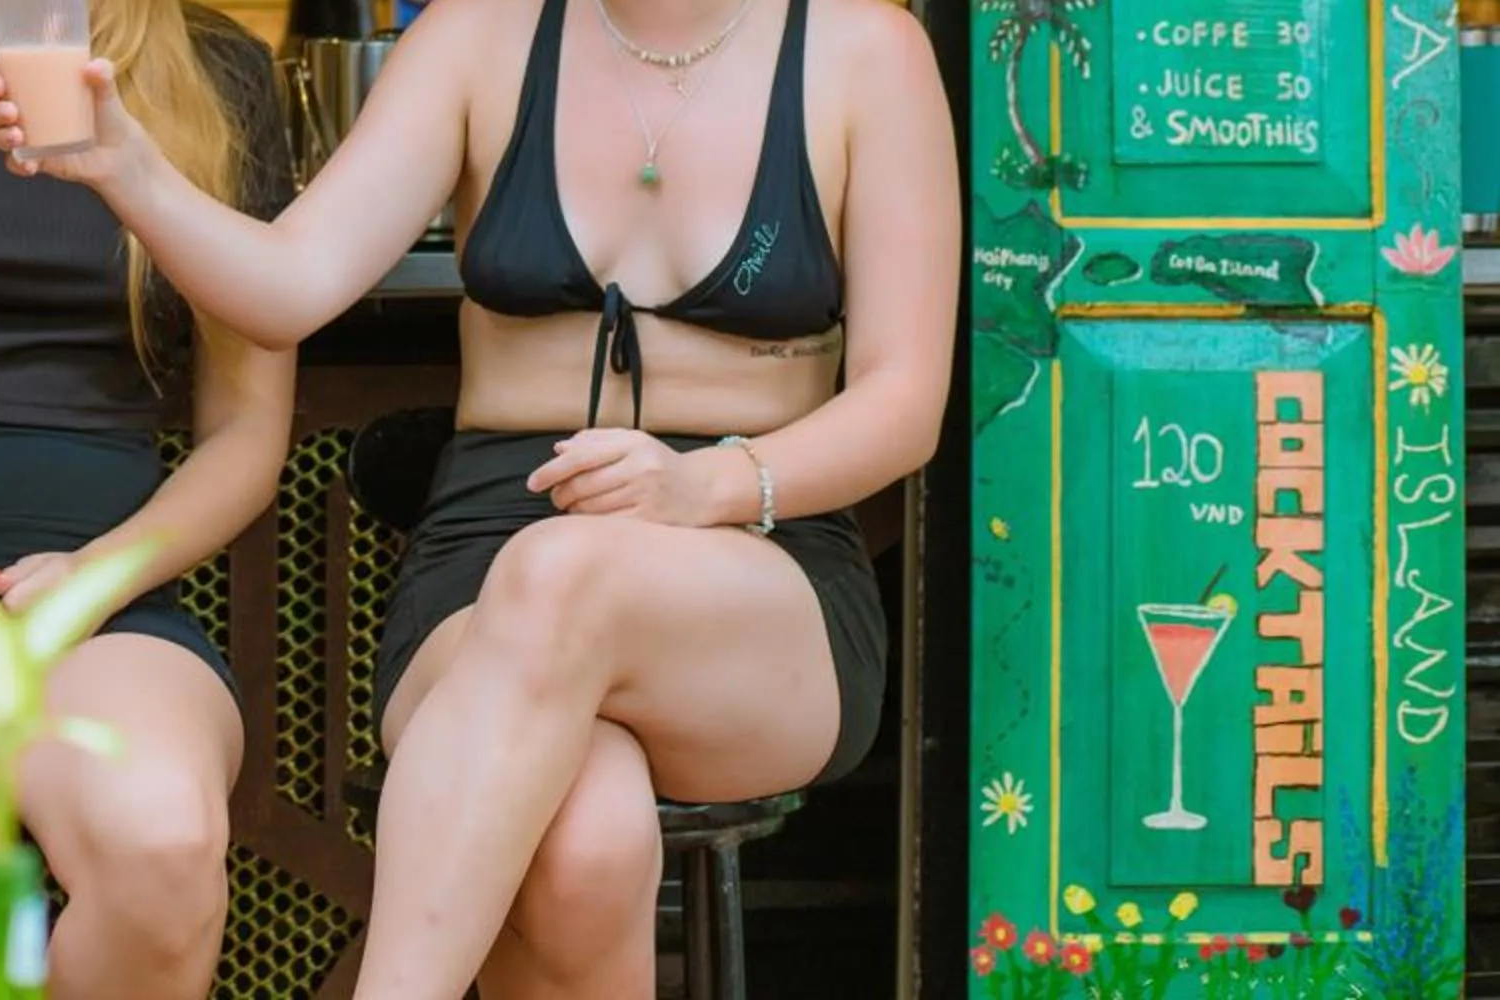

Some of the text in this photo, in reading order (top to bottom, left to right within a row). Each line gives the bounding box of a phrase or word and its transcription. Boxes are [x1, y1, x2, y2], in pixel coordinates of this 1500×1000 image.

[1277, 20, 1311, 45] 30
[1277, 71, 1312, 100] 50
[1130, 103, 1154, 139] &
[1133, 416, 1224, 489] 120
[1190, 503, 1244, 525] VND
[1393, 424, 1456, 744] ISLAND
[1253, 371, 1323, 886] COCKTAILS
